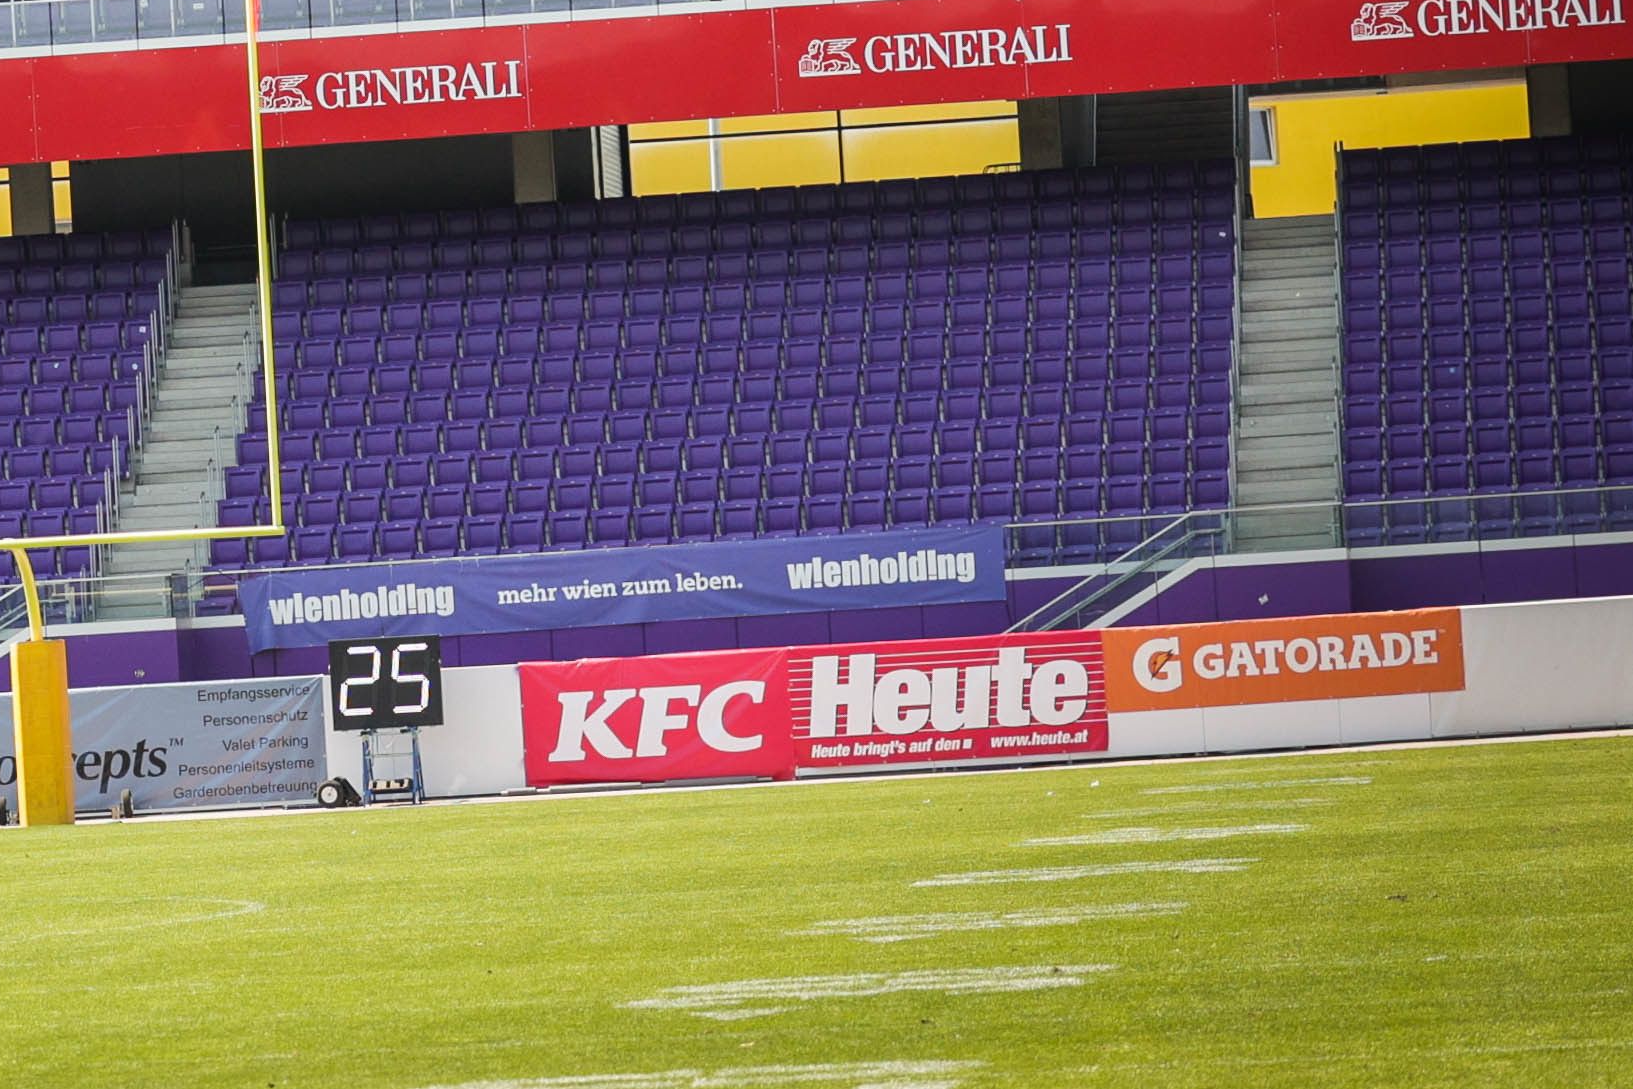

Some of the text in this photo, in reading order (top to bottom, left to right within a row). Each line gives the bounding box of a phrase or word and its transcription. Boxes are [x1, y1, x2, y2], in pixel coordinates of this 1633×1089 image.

[864, 24, 1072, 73] GENERALI
[316, 60, 522, 109] GENERALI
[497, 572, 744, 605] mehr wien zum leben.
[1132, 630, 1438, 693] G GATORADE
[339, 642, 431, 716] 25
[809, 645, 1088, 738] Heute
[197, 683, 310, 703] Empfangsservice
[203, 710, 308, 727] Personenschutz
[548, 680, 765, 763] KFC
[222, 736, 308, 752] Valet Parking
[811, 738, 960, 758] Heute bringt's auf den
[990, 729, 1088, 747] www.heute.at
[179, 758, 315, 776] Personenleitsysteme
[173, 781, 318, 799] Garderobenbetreuung
